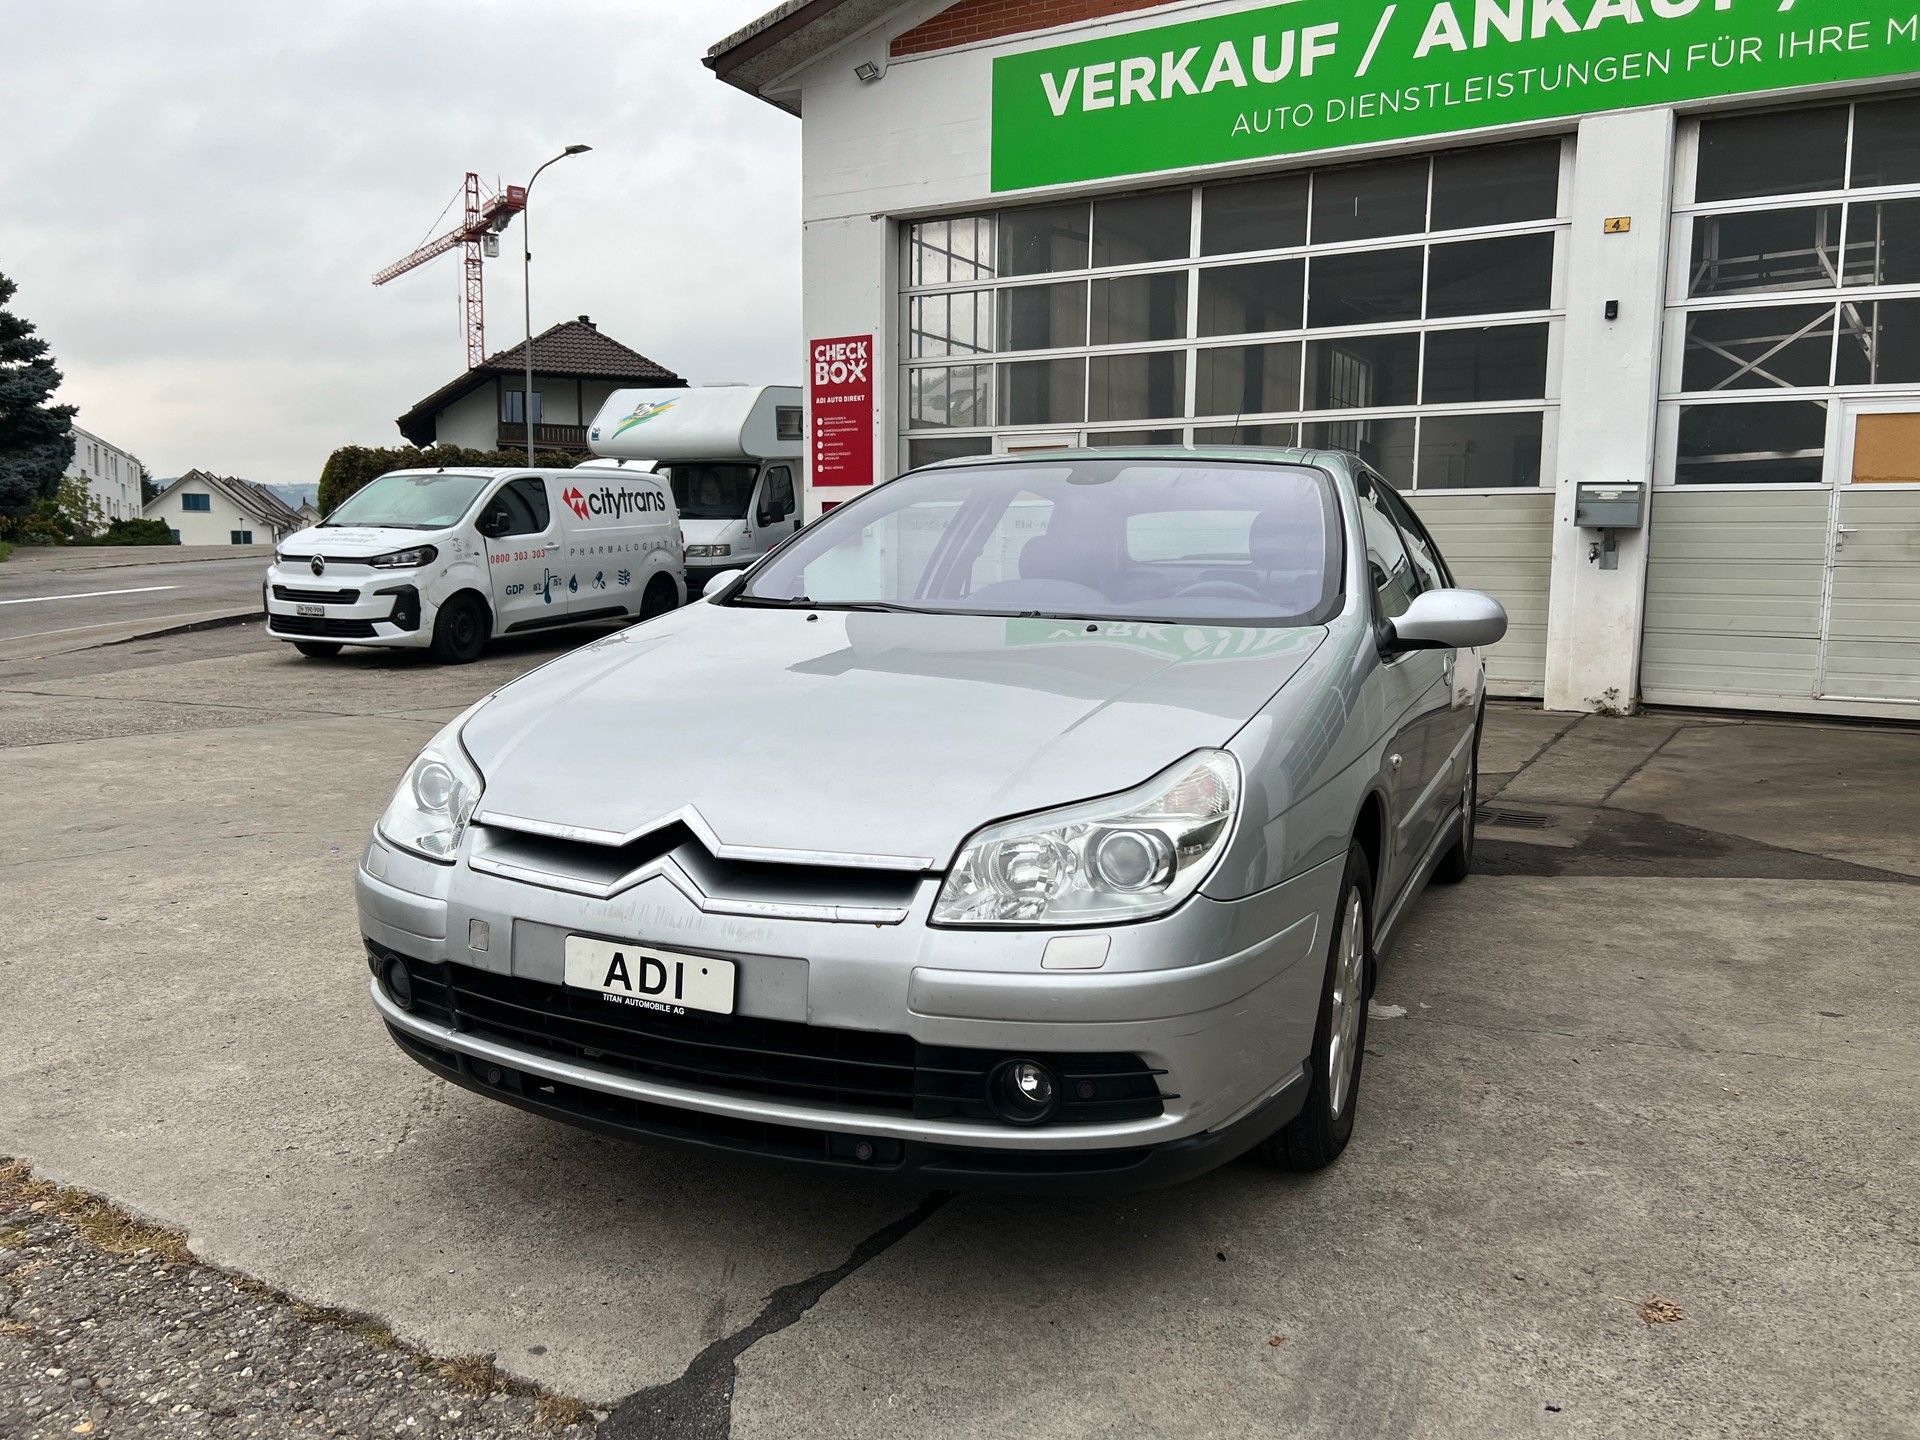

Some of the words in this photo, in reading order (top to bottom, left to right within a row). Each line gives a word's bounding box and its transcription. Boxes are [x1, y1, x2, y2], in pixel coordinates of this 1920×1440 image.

[1039, 21, 1339, 117] VERKAUF
[1231, 103, 1314, 137] AUTO
[1326, 48, 1671, 123] DIENSTLEISTUNGEN
[1687, 35, 1763, 72] FÜR
[1779, 21, 1871, 59] IHRE
[1611, 219, 1621, 231] 4
[814, 341, 868, 362] CHECK
[815, 359, 868, 386] BOX
[843, 394, 865, 402] DIREKT
[588, 486, 666, 519] citytrans
[490, 553, 510, 565] 0800
[514, 551, 528, 562] 303
[532, 549, 546, 560] 303
[505, 583, 524, 596] GDP
[603, 951, 684, 1000] ADI
[602, 993, 623, 1004] TITAN
[624, 997, 671, 1013] AUTOMOBILE
[673, 1006, 685, 1015] AG
